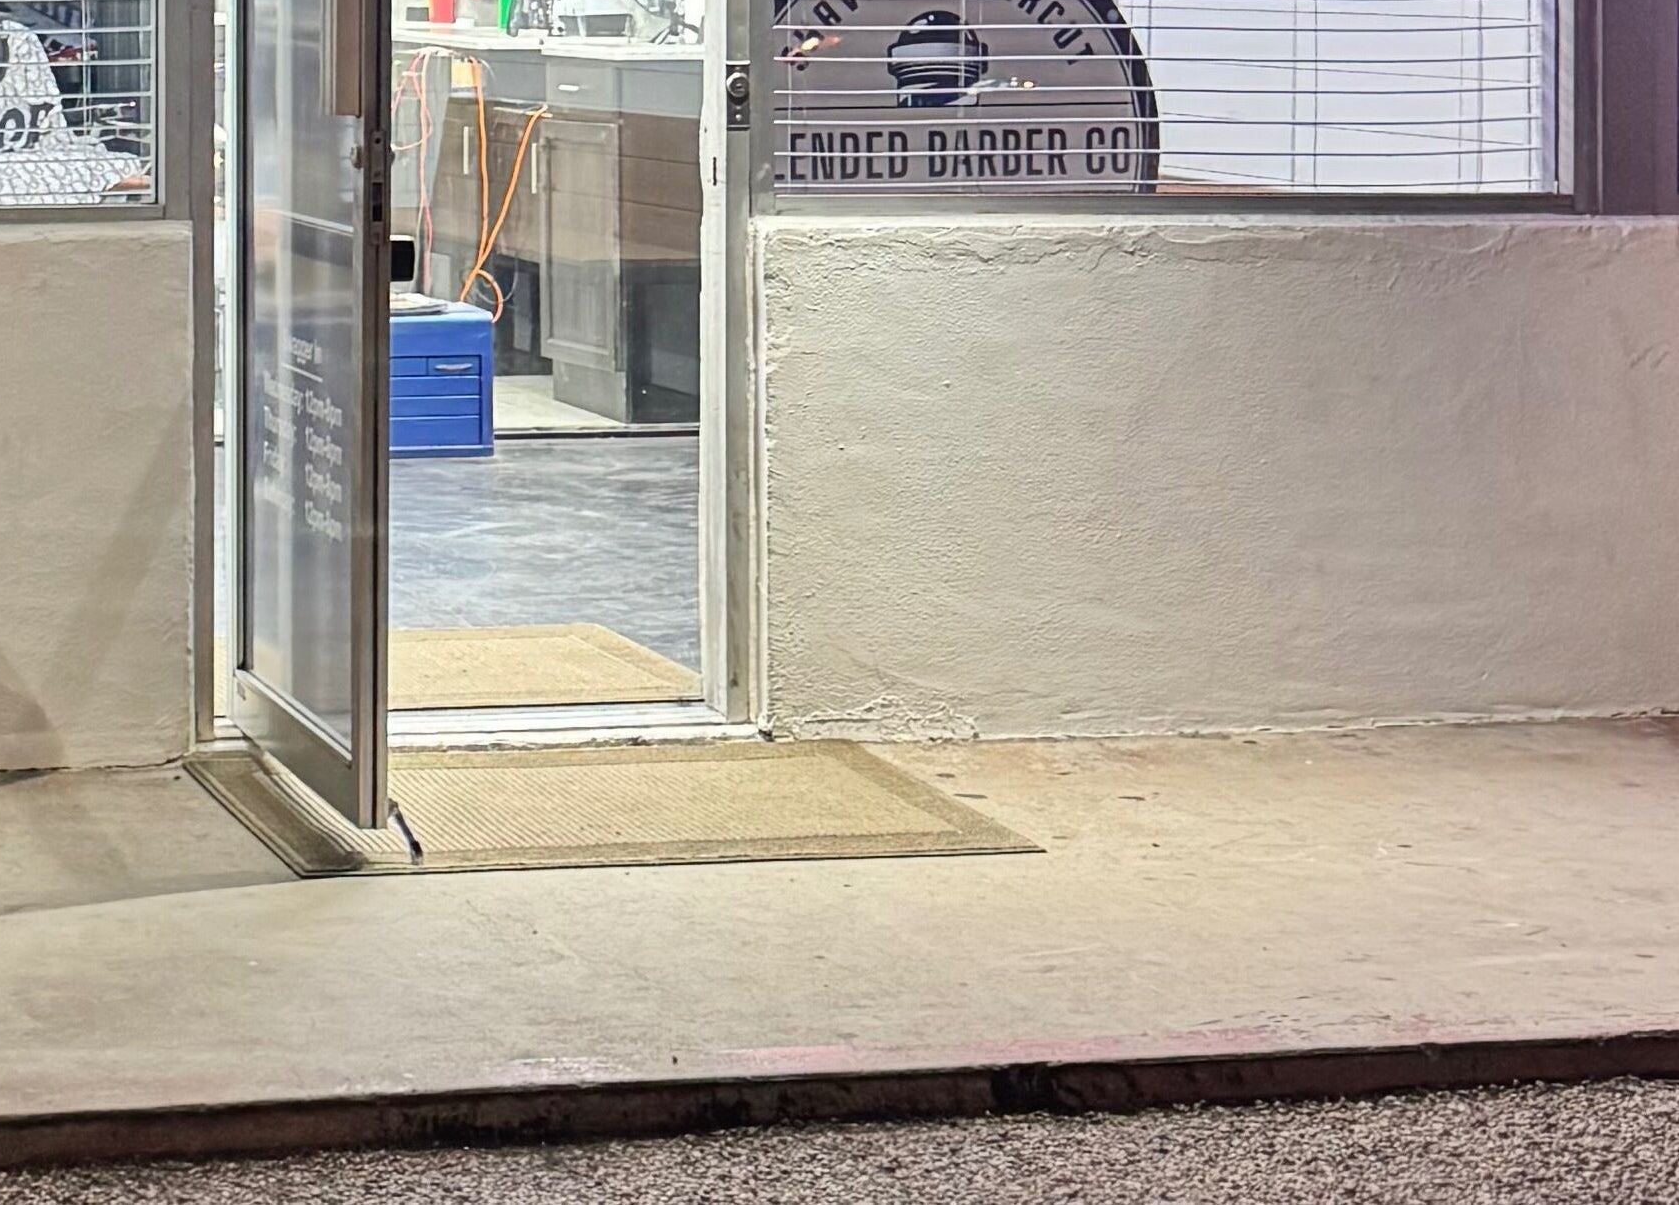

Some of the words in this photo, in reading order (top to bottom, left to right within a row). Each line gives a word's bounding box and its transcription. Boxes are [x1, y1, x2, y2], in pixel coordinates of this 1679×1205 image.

[774, 131, 909, 181] ENDED
[927, 128, 1068, 178] BARBER
[1085, 126, 1132, 175] CO
